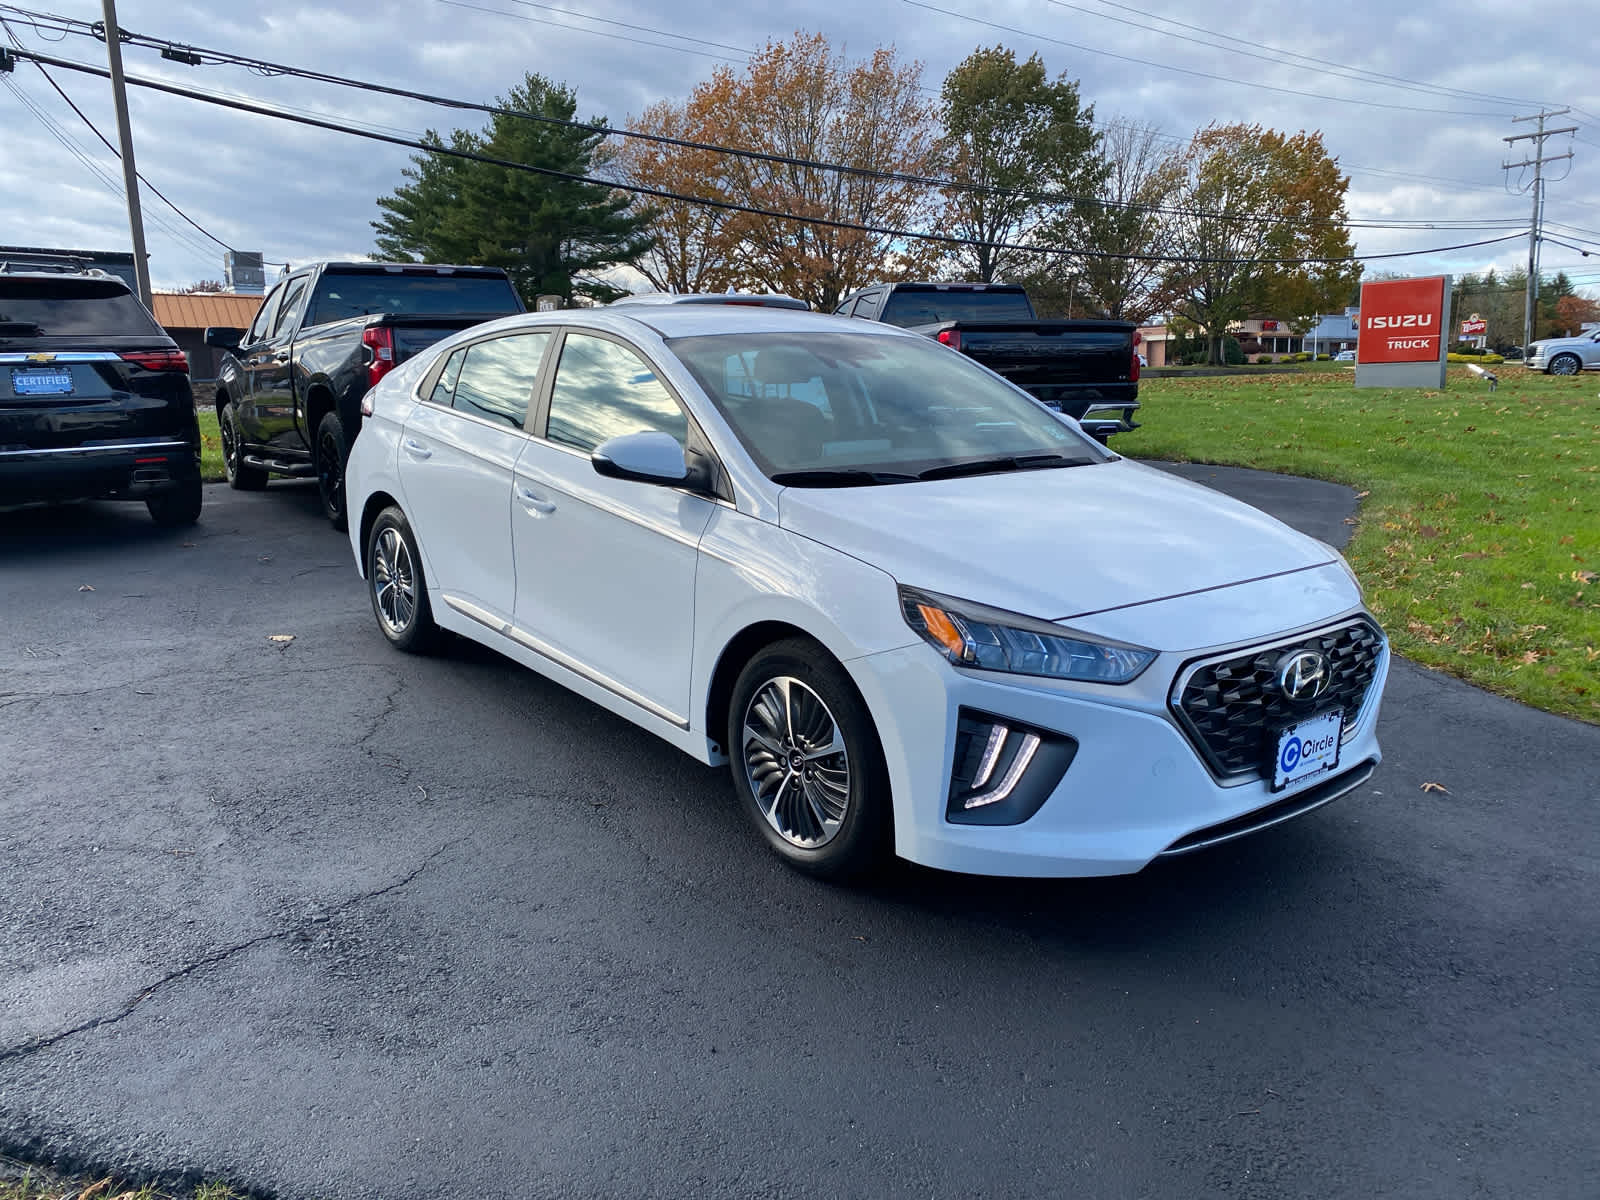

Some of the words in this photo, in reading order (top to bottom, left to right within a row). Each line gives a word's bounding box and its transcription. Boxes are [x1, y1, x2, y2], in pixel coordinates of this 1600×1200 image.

[1367, 313, 1432, 329] ISUZU
[1387, 339, 1430, 350] TRUCK
[15, 375, 69, 386] CERTIFIED
[1301, 735, 1334, 758] Circle
